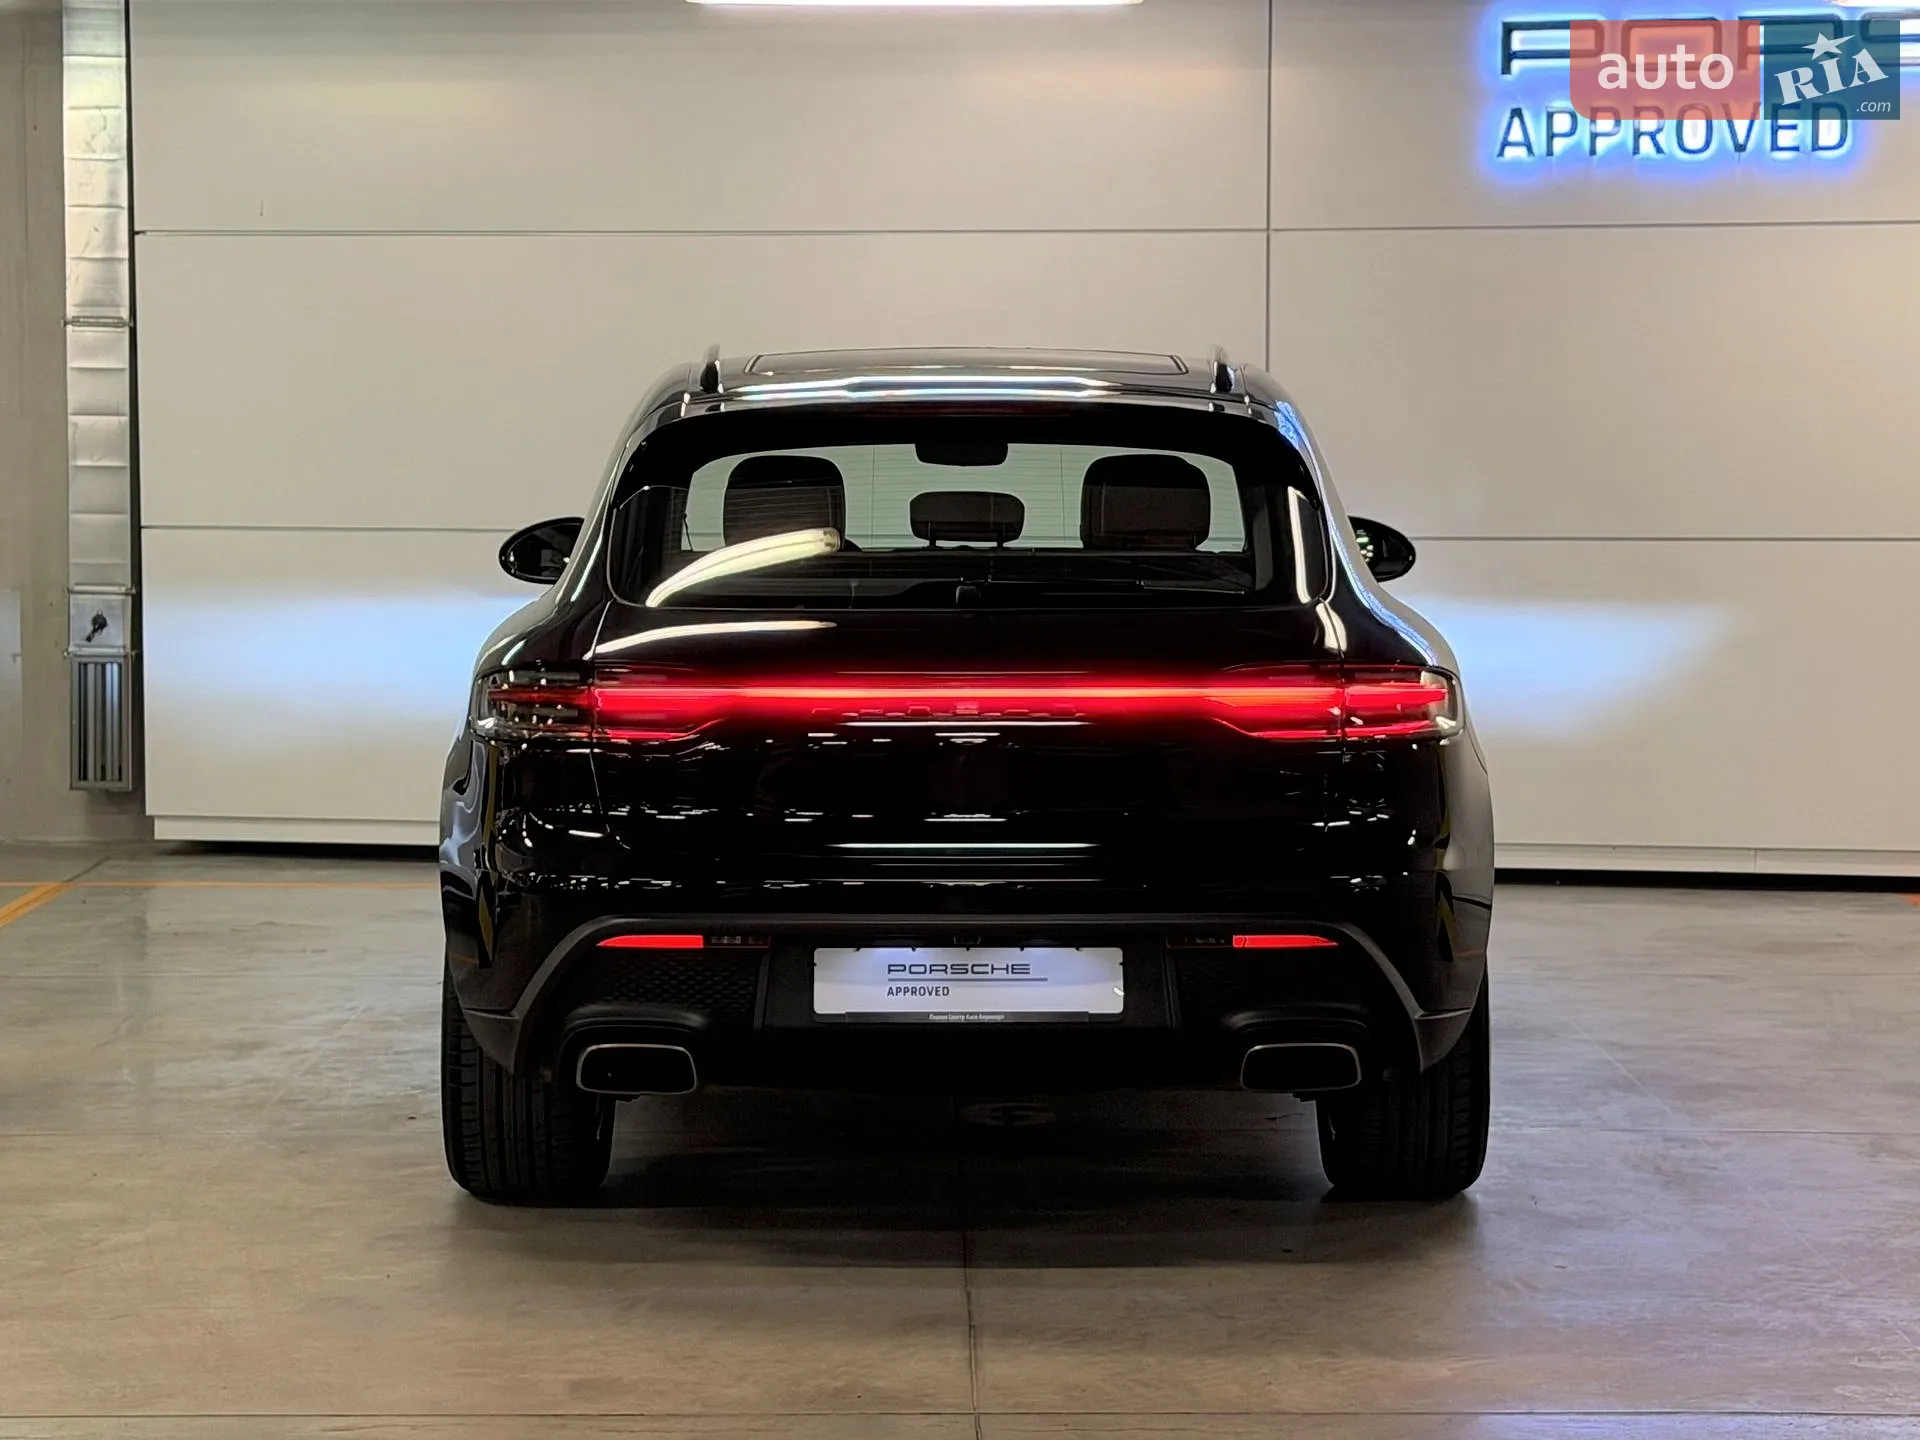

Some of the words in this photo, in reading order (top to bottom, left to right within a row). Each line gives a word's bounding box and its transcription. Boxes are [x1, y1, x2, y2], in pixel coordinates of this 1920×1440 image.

[1497, 103, 1848, 157] APPROVED
[888, 964, 1030, 975] PORSCHE
[887, 986, 950, 997] APPROVED
